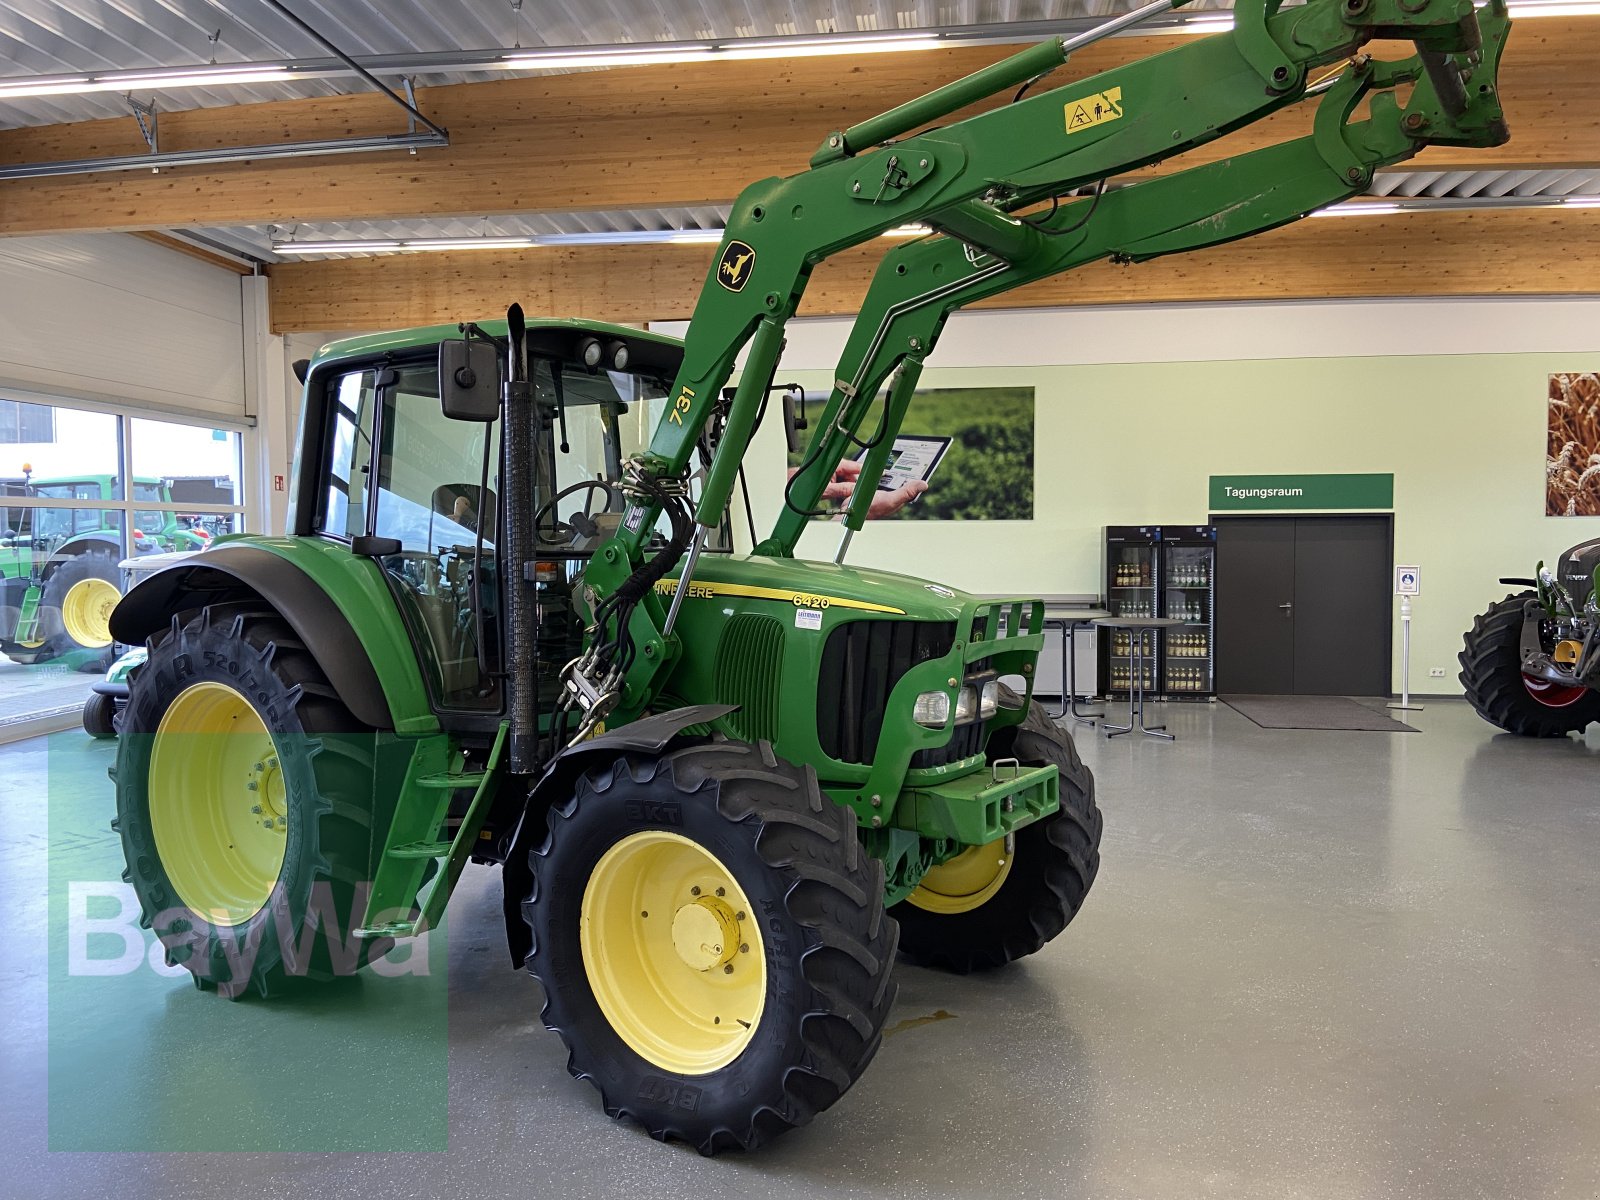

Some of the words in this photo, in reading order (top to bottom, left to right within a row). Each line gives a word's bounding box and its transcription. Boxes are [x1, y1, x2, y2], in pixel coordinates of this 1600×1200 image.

[668, 385, 696, 426] 731
[1225, 487, 1303, 499] Tagungsraum
[792, 594, 830, 609] 6420
[623, 799, 681, 825] BKT
